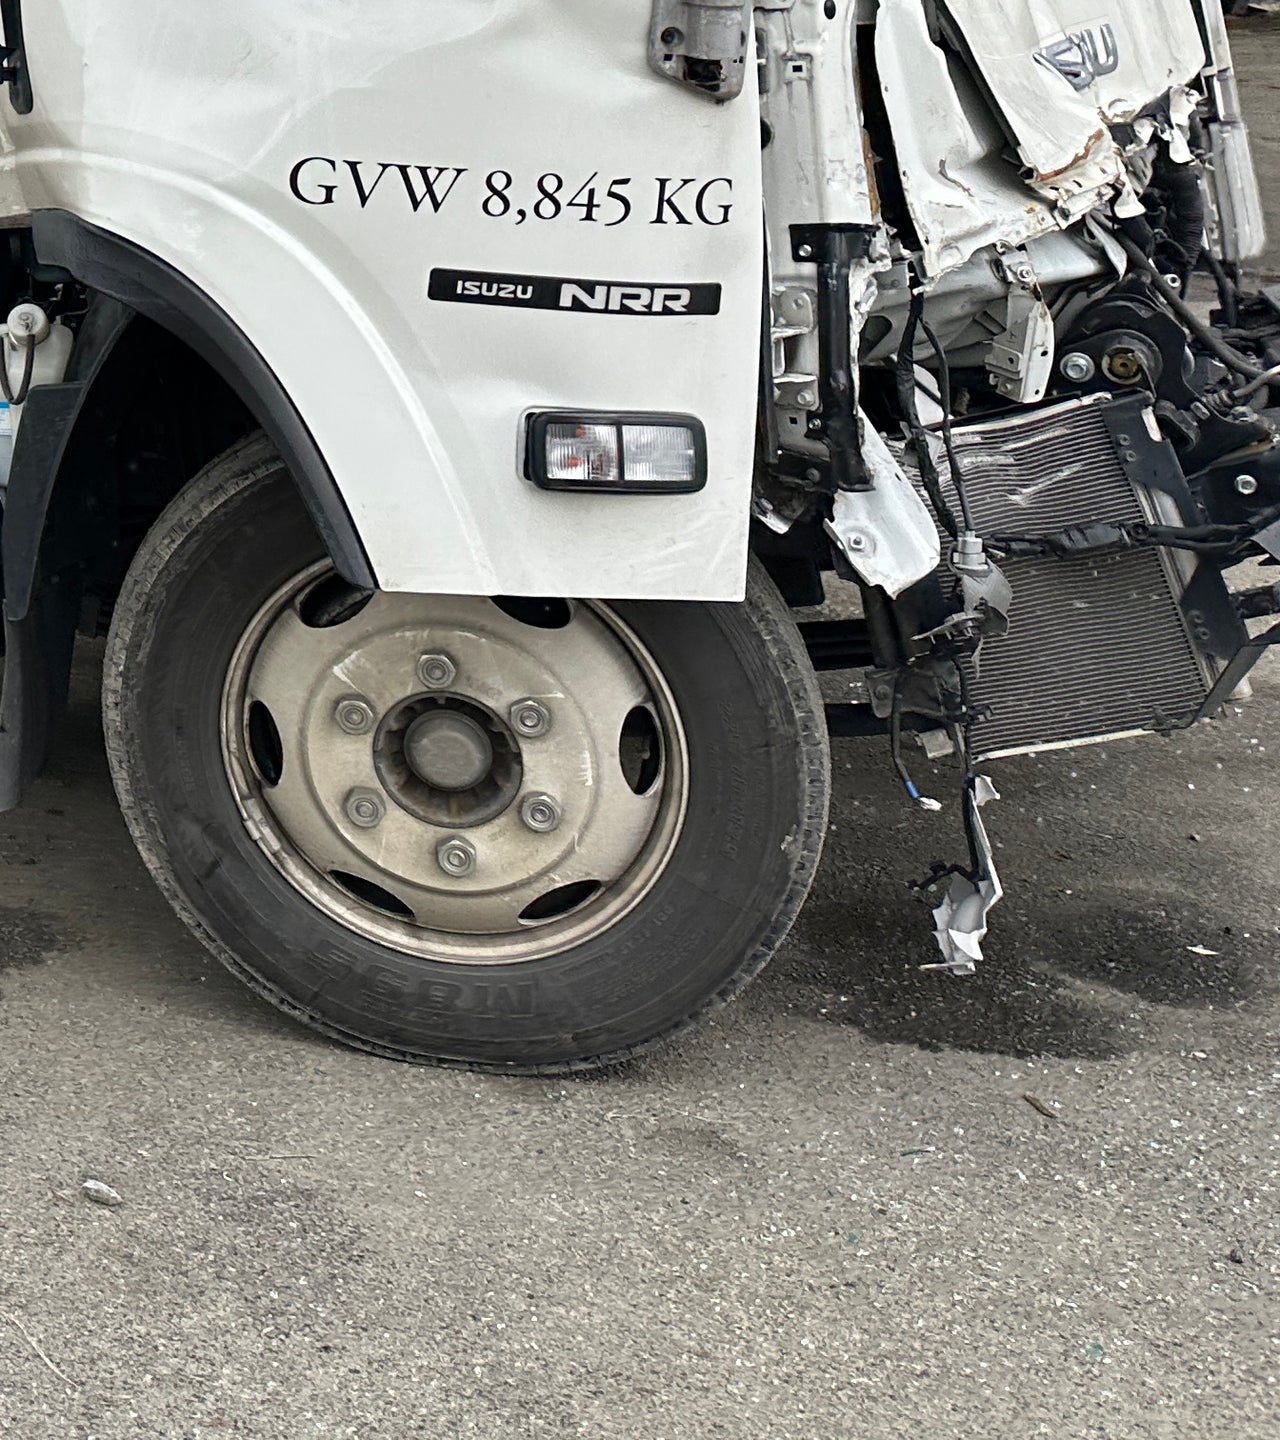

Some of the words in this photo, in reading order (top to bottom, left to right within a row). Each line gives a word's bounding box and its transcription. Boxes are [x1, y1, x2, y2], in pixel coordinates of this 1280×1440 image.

[288, 156, 468, 214] GVW
[481, 169, 632, 227] 8,845
[649, 176, 734, 226] KG
[455, 278, 534, 300] ISUZU
[558, 282, 691, 313] NRR
